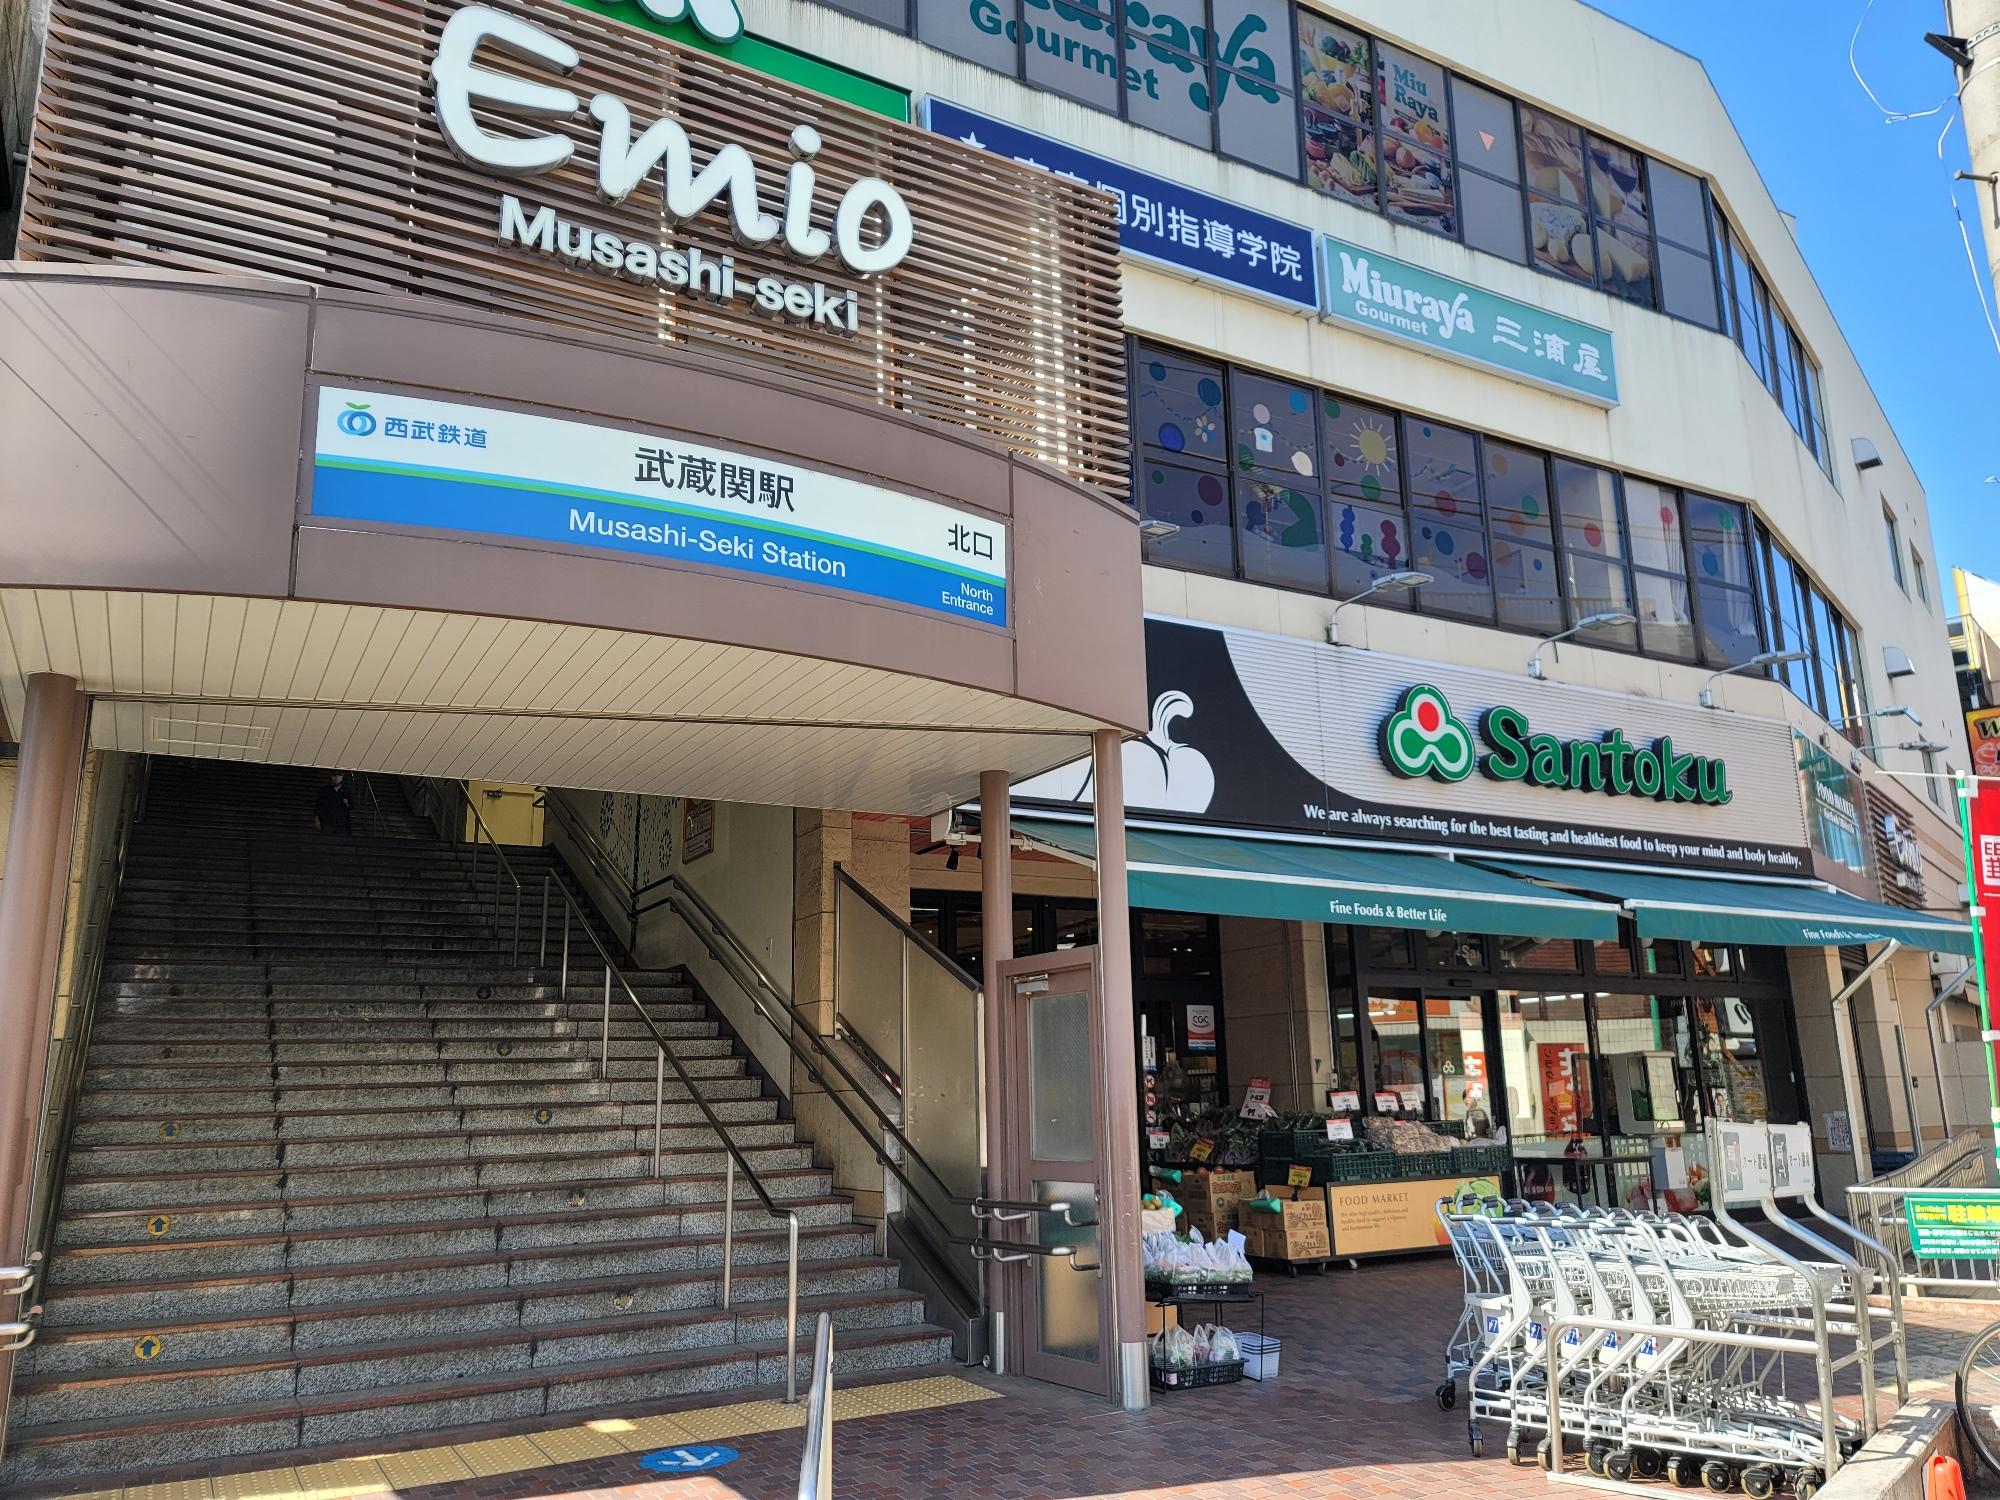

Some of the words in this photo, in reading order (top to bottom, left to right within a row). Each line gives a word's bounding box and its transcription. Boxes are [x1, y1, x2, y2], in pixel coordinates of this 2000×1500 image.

[969, 0, 1159, 100] Gourmet
[1392, 63, 1428, 97] Miu
[1394, 82, 1439, 122] Raya
[432, 5, 914, 278] Emio
[499, 194, 859, 334] Musashi-seki
[1339, 252, 1475, 339] Miuraya
[1355, 300, 1429, 336] Gourmet
[1492, 315, 1608, 382] 三浦屋
[384, 415, 488, 451] 西武鉄道
[634, 446, 795, 513] 武蔵関駅
[568, 508, 755, 562] Musashi-Seki
[761, 541, 847, 580] Station
[948, 523, 993, 561] 北口
[941, 590, 994, 617] Entrance
[960, 583, 993, 603] North
[1484, 705, 1733, 805] Santoku
[1303, 803, 1325, 820] We
[1328, 808, 1349, 821] are
[1351, 808, 1392, 829] always
[1394, 815, 1449, 835] searching
[1451, 817, 1467, 834] for
[1469, 820, 1488, 835] the
[1489, 821, 1512, 838] best
[1514, 826, 1550, 845] tasting
[1550, 830, 1568, 842] and
[1571, 830, 1618, 848] healthiest
[1620, 835, 1641, 851] food
[1643, 839, 1654, 851] to
[1655, 839, 1677, 857] keep
[1679, 845, 1700, 858] your
[1702, 844, 1725, 858] mind
[1727, 846, 1743, 861] and
[1744, 848, 1766, 865] body
[1767, 851, 1802, 870] healthy.
[1329, 899, 1352, 914] Fine
[1354, 902, 1384, 917] Foods
[1385, 905, 1395, 918] &
[1396, 905, 1427, 921] Better
[1429, 908, 1447, 922] Life
[1802, 927, 1820, 940] Fine
[1339, 1195, 1368, 1206] FOOD
[1372, 1192, 1409, 1204] MARKET
